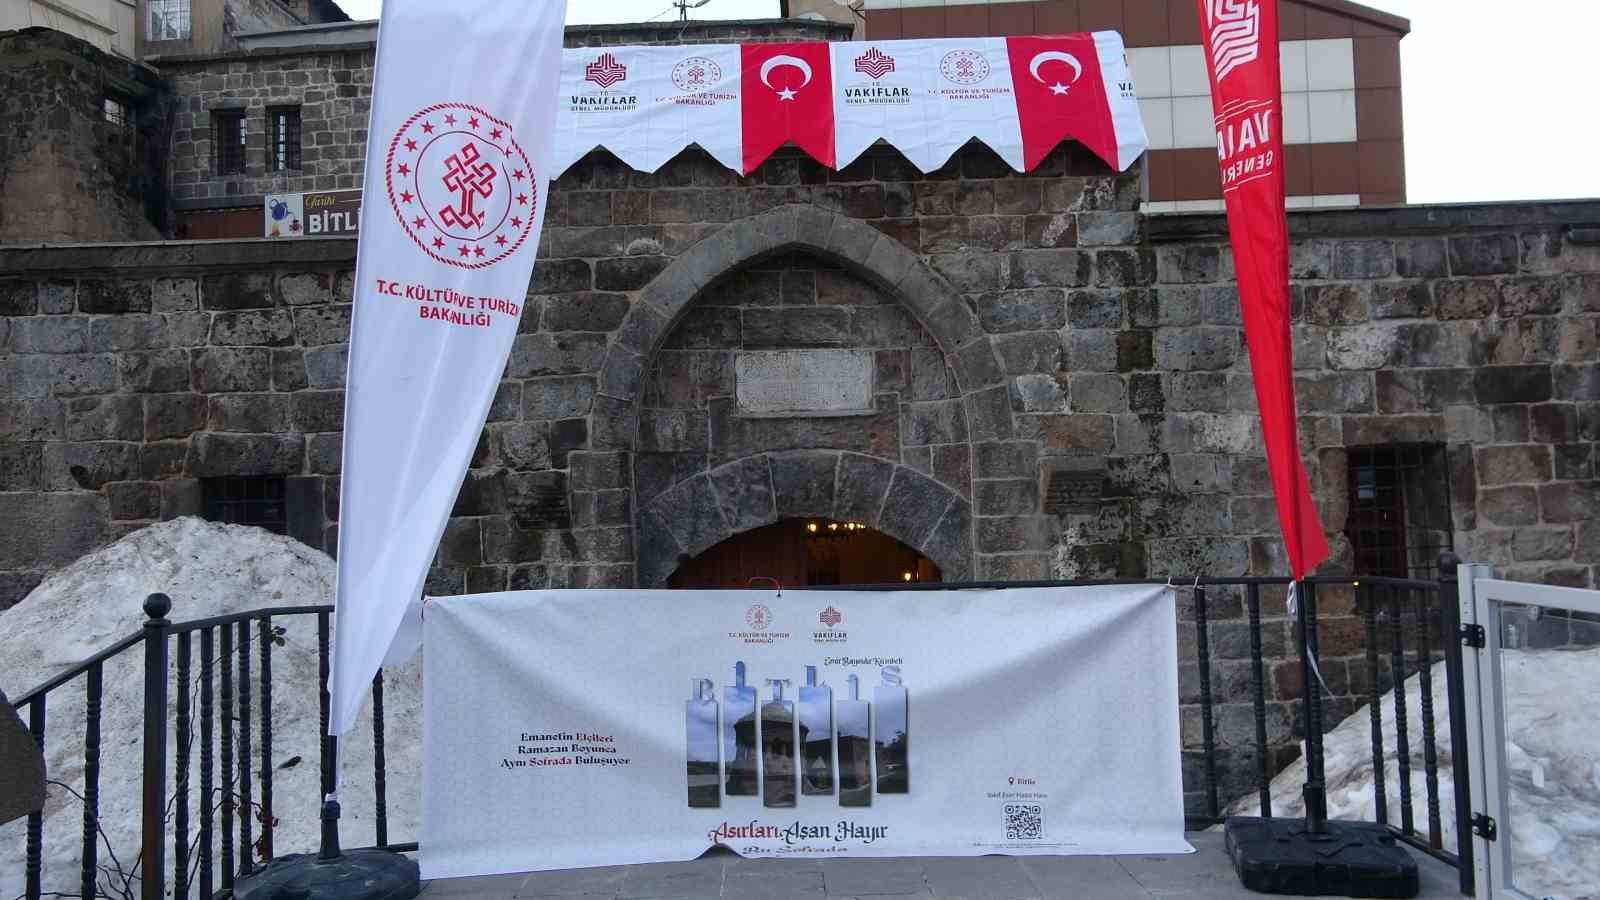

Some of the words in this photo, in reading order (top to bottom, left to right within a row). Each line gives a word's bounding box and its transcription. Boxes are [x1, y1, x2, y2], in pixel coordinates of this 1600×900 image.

[845, 87, 910, 97] VAKIFLAR
[571, 95, 637, 105] VAKIFLAR
[376, 279, 403, 297] T.C.
[458, 295, 475, 309] VE
[419, 305, 491, 327] BAKNLIĞI
[520, 731, 573, 742] Emanetin
[576, 732, 614, 743] Elçileri
[518, 744, 569, 755] Ramazan
[571, 743, 617, 755] Boyunca
[528, 756, 572, 767] Sofrada
[575, 755, 631, 767] Buluşuyor
[707, 820, 779, 845] Asırları
[779, 820, 831, 845] Aşan
[834, 820, 888, 844] Hayır
